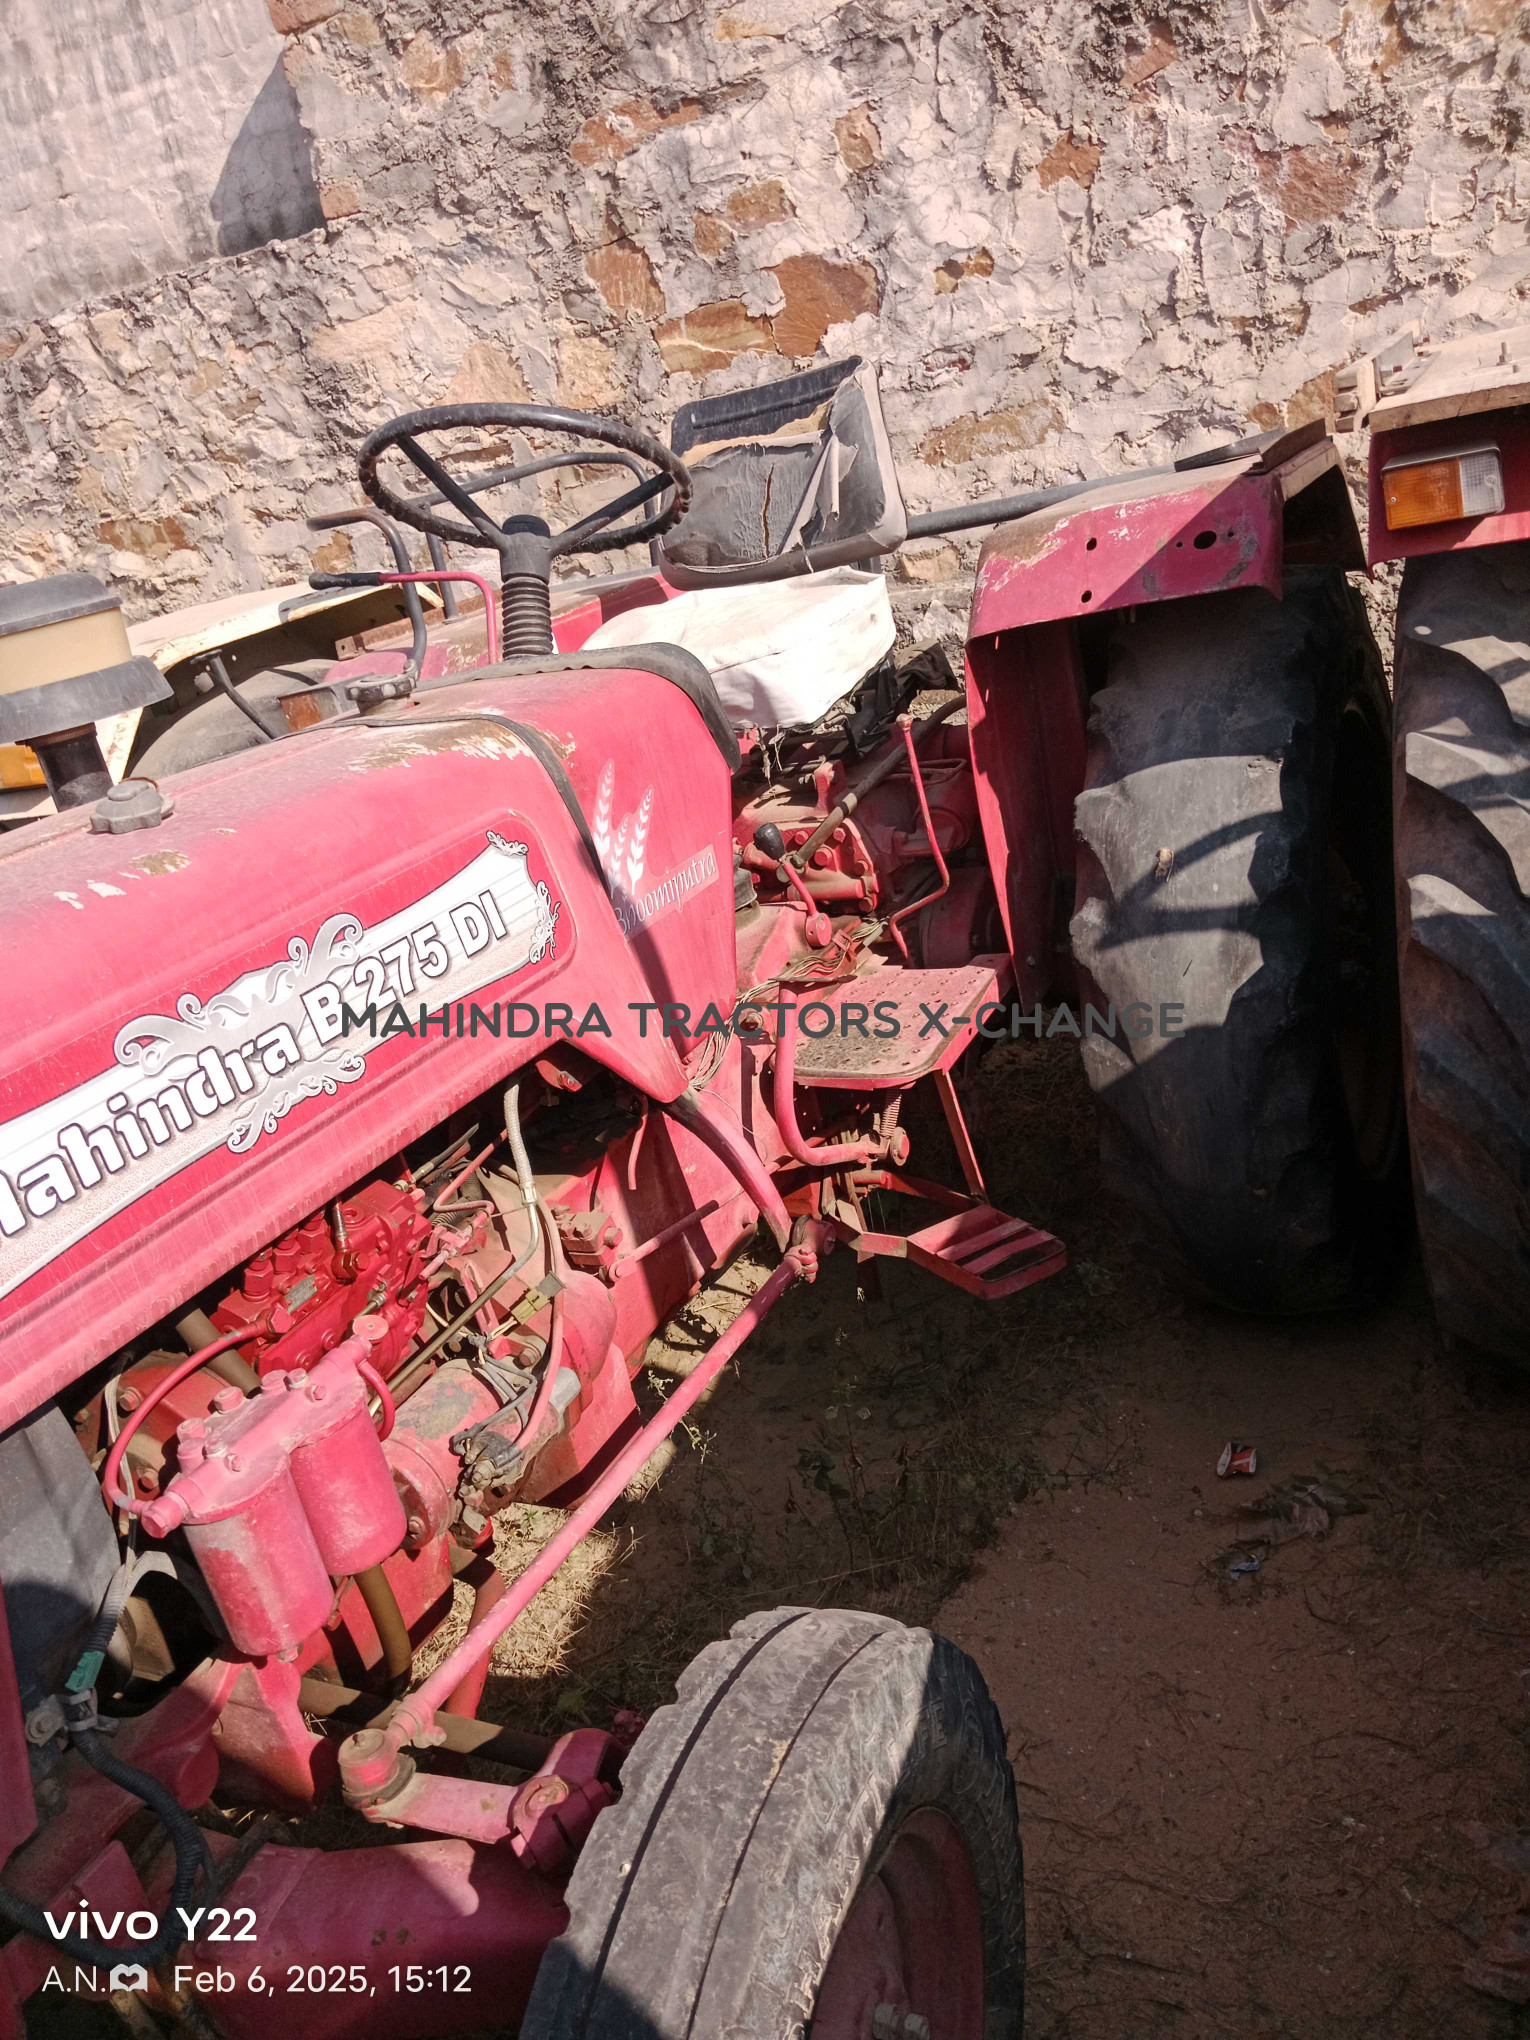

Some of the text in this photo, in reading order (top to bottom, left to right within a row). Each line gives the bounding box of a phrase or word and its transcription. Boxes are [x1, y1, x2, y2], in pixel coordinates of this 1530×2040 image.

[300, 980, 346, 1048] B
[353, 920, 450, 1016] 275
[449, 889, 508, 958] DI
